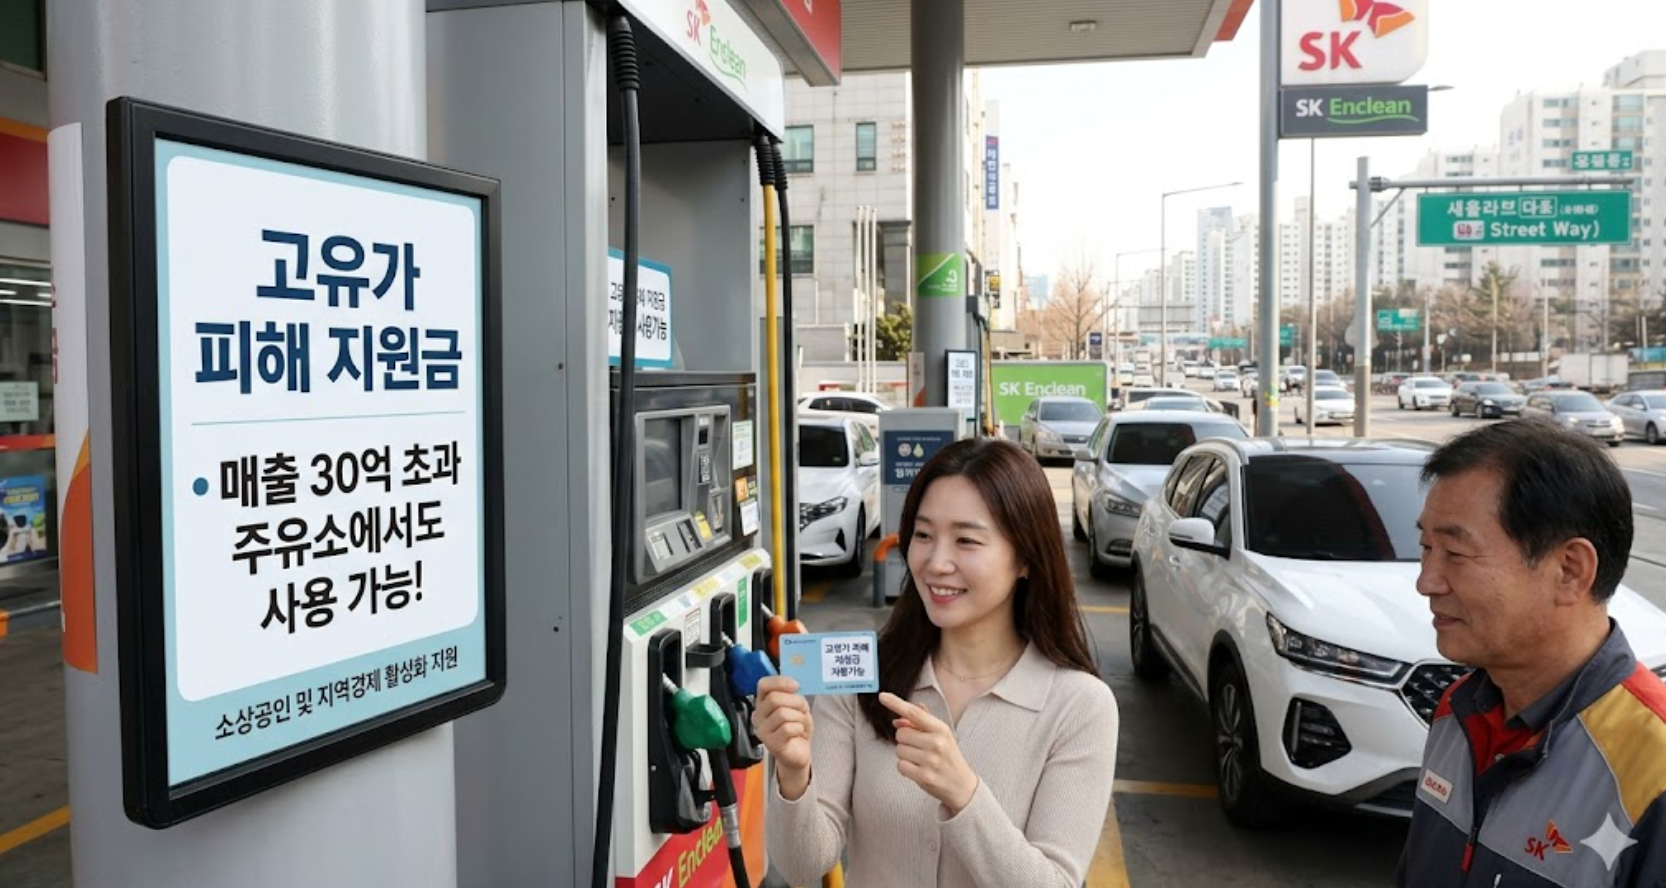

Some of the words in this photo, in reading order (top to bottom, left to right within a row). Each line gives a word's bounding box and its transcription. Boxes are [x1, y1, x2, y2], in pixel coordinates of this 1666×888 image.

[687, 9, 702, 47] SK
[710, 24, 746, 80] Enclean
[1298, 31, 1362, 71] SK
[1295, 98, 1323, 117] SK
[1329, 96, 1412, 115] Enclean
[1490, 221, 1546, 237] Street
[1553, 220, 1600, 240] Way)
[256, 229, 420, 311] 고유가
[195, 321, 310, 394] 피해
[327, 325, 462, 392] 지원금
[999, 381, 1020, 396] SK
[1025, 381, 1086, 396] Enclean
[220, 452, 299, 508] 매출
[310, 445, 391, 497] 30억
[402, 441, 462, 488] 초과
[232, 500, 445, 575] 주유소에서도
[260, 576, 338, 634] 사용
[348, 560, 423, 614] 가능!
[215, 695, 291, 740] 소상공인
[296, 688, 312, 717] 및
[317, 668, 381, 708] 지역경제
[385, 655, 428, 688] 활성화
[431, 646, 458, 672] 지원
[1524, 837, 1549, 861] SK
